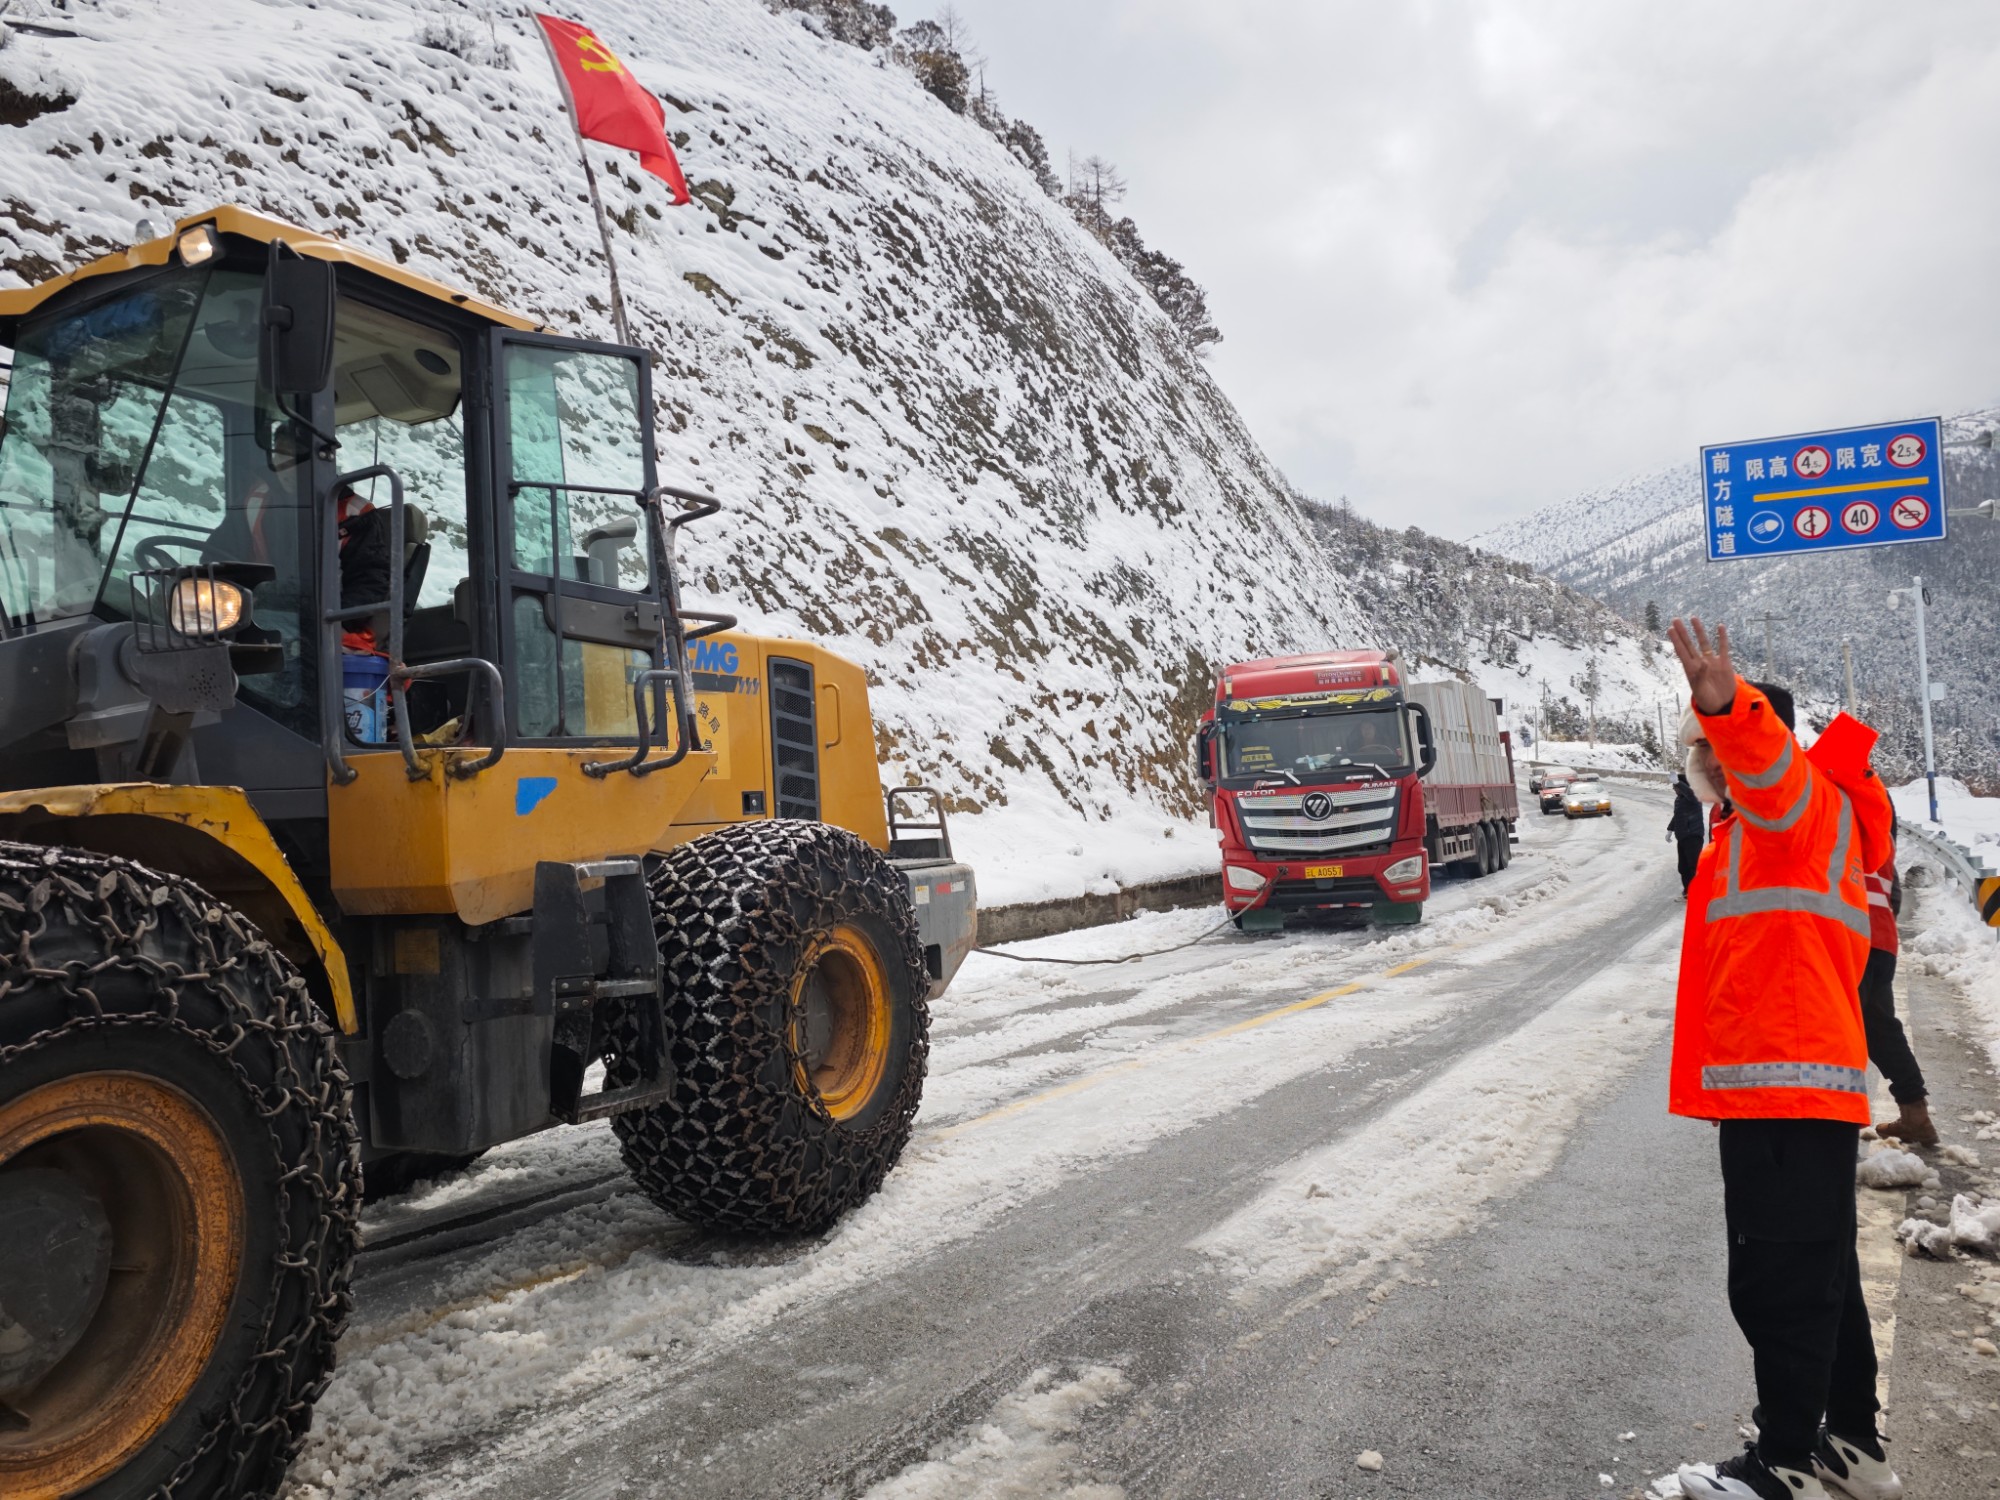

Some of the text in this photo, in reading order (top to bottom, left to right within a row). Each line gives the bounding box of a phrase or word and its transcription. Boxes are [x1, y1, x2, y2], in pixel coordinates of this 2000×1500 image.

[1745, 455, 1788, 481] 限高
[1836, 444, 1882, 470] 限宽
[1711, 451, 1736, 554] 前方隧道
[1850, 508, 1869, 527] 40
[1237, 789, 1276, 797] FOTON
